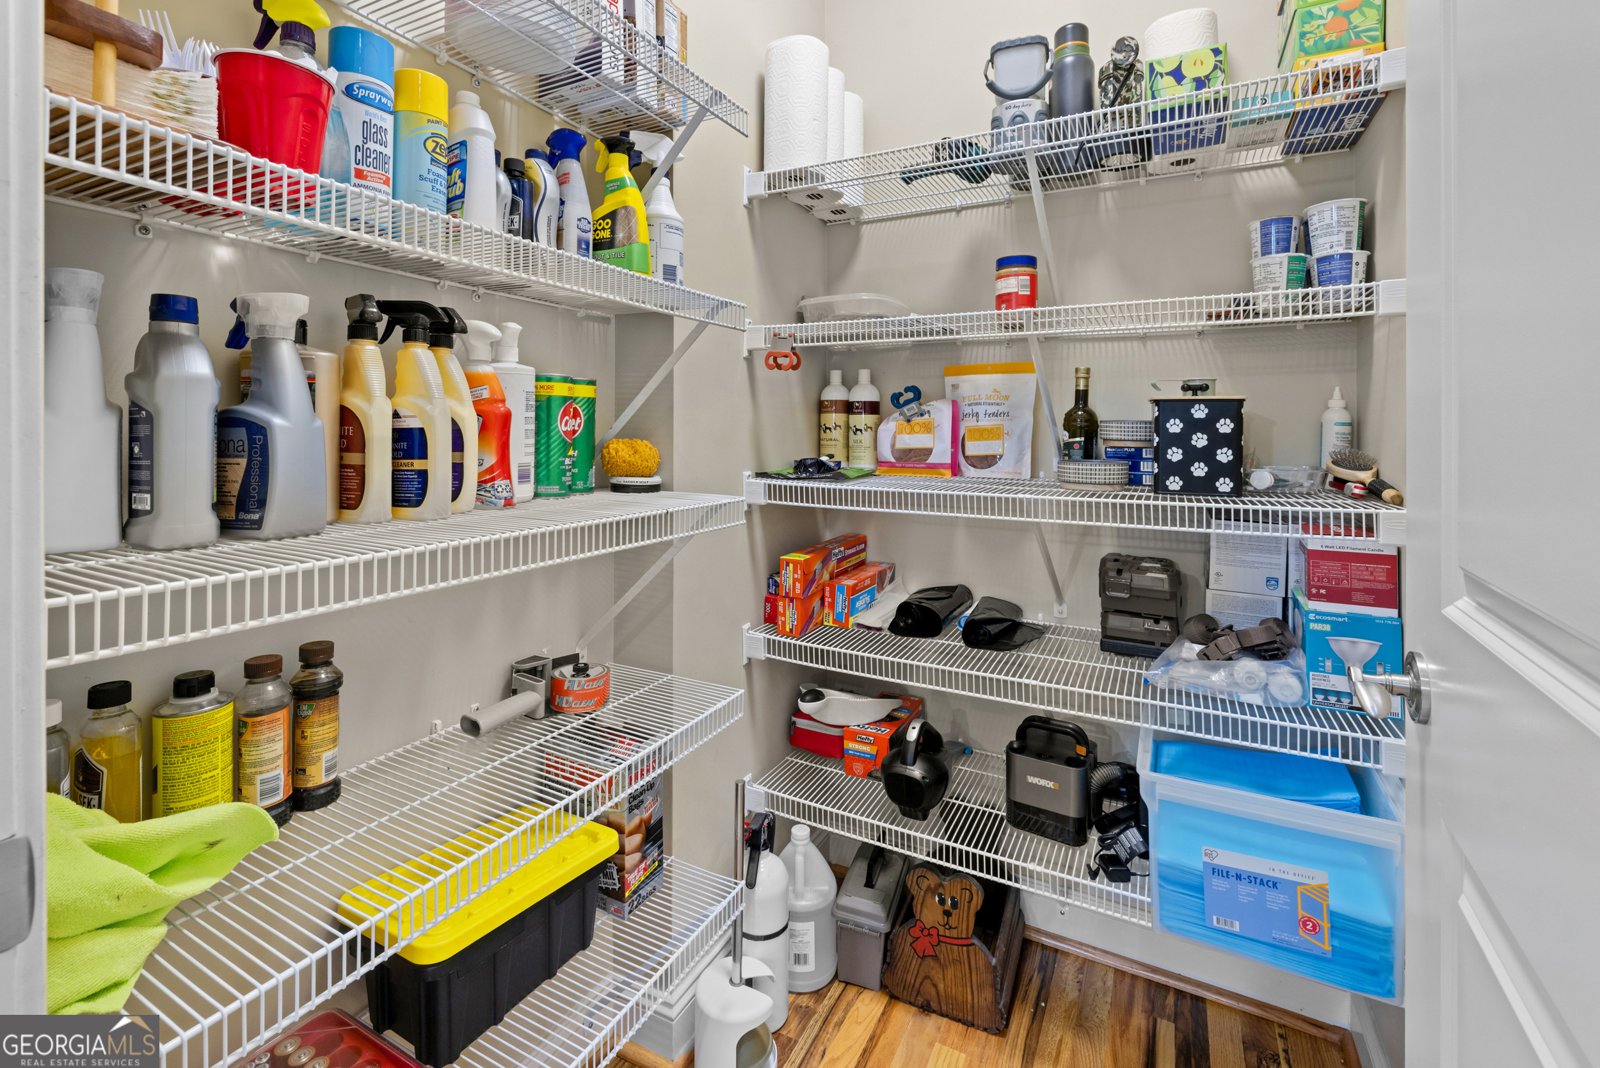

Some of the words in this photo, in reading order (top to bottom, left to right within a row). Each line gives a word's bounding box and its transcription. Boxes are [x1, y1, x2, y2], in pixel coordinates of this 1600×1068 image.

[362, 118, 388, 149] glass
[354, 143, 391, 175] cleaner
[352, 182, 382, 194] AMMONIA
[985, 394, 1010, 402] MOON
[961, 408, 980, 423] jerky
[983, 409, 1010, 418] tenders
[899, 422, 932, 434] 100%
[220, 438, 246, 454] ona
[249, 435, 264, 511] Professional
[238, 512, 260, 520] Bona
[857, 735, 874, 743] Hefty
[848, 743, 871, 752] STRONG
[1026, 775, 1058, 790] WORX
[628, 799, 645, 814] Bags
[1212, 867, 1279, 890] FILE-N-STACK
[627, 893, 642, 915] 22
[1306, 921, 1313, 930] 2
